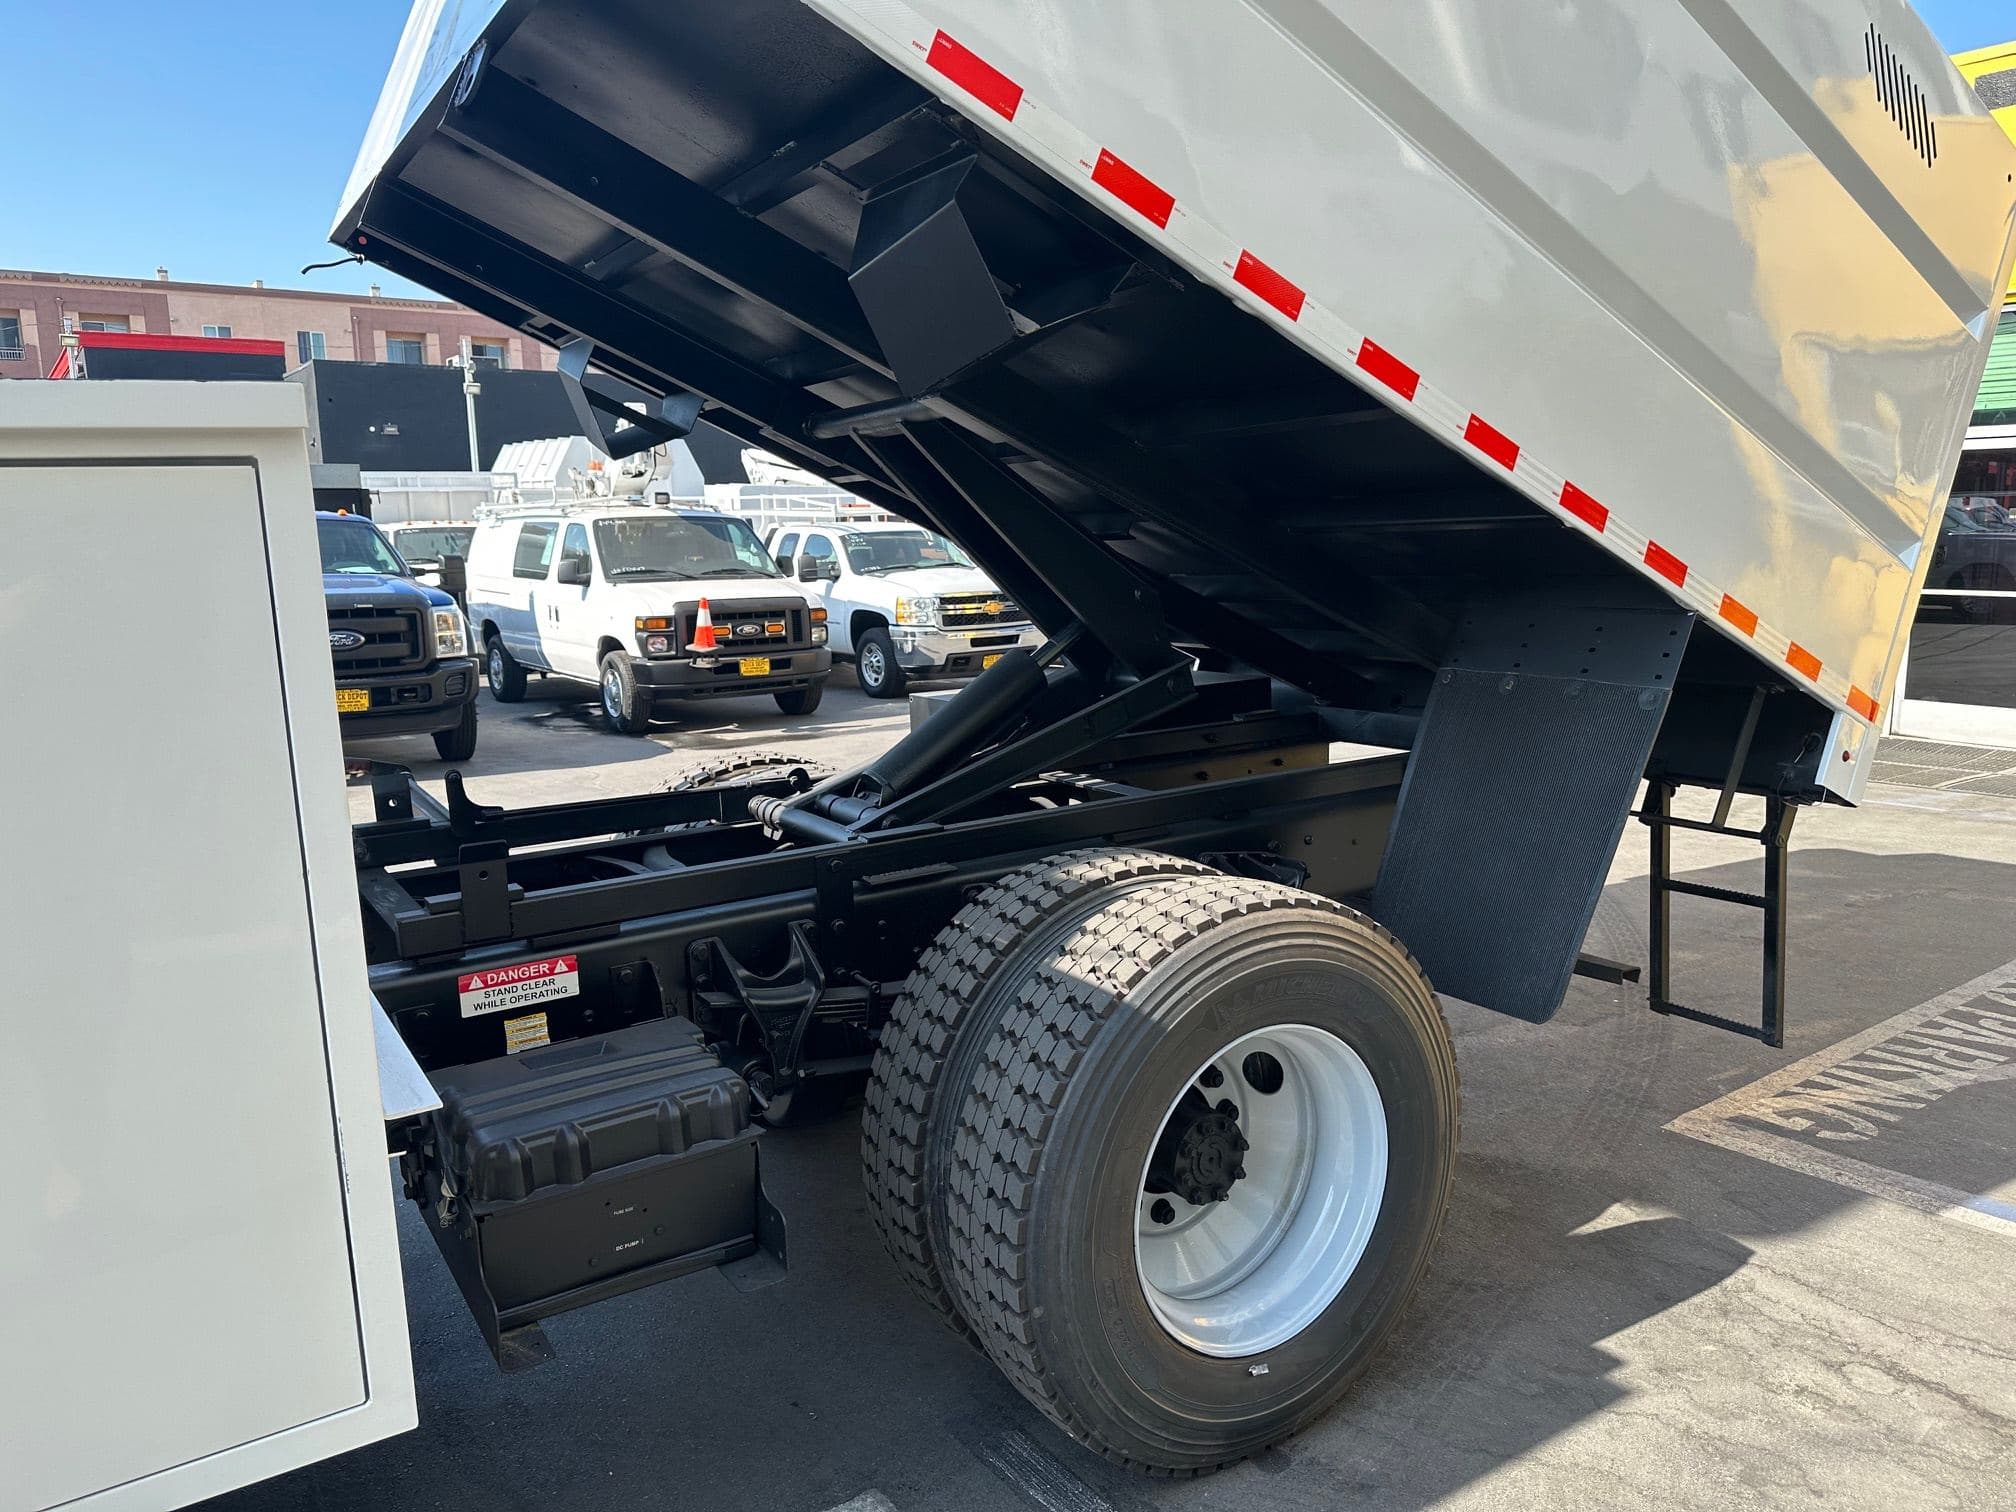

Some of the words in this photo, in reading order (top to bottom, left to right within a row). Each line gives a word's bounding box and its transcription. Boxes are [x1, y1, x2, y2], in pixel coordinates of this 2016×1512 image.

[329, 634, 354, 646] Ford
[347, 692, 367, 700] DEPOT
[487, 963, 550, 985] DANGER
[473, 998, 507, 1012] WHILE
[509, 986, 568, 1004] OPERATING
[484, 985, 519, 999] STAND
[521, 978, 556, 992] CLEAR
